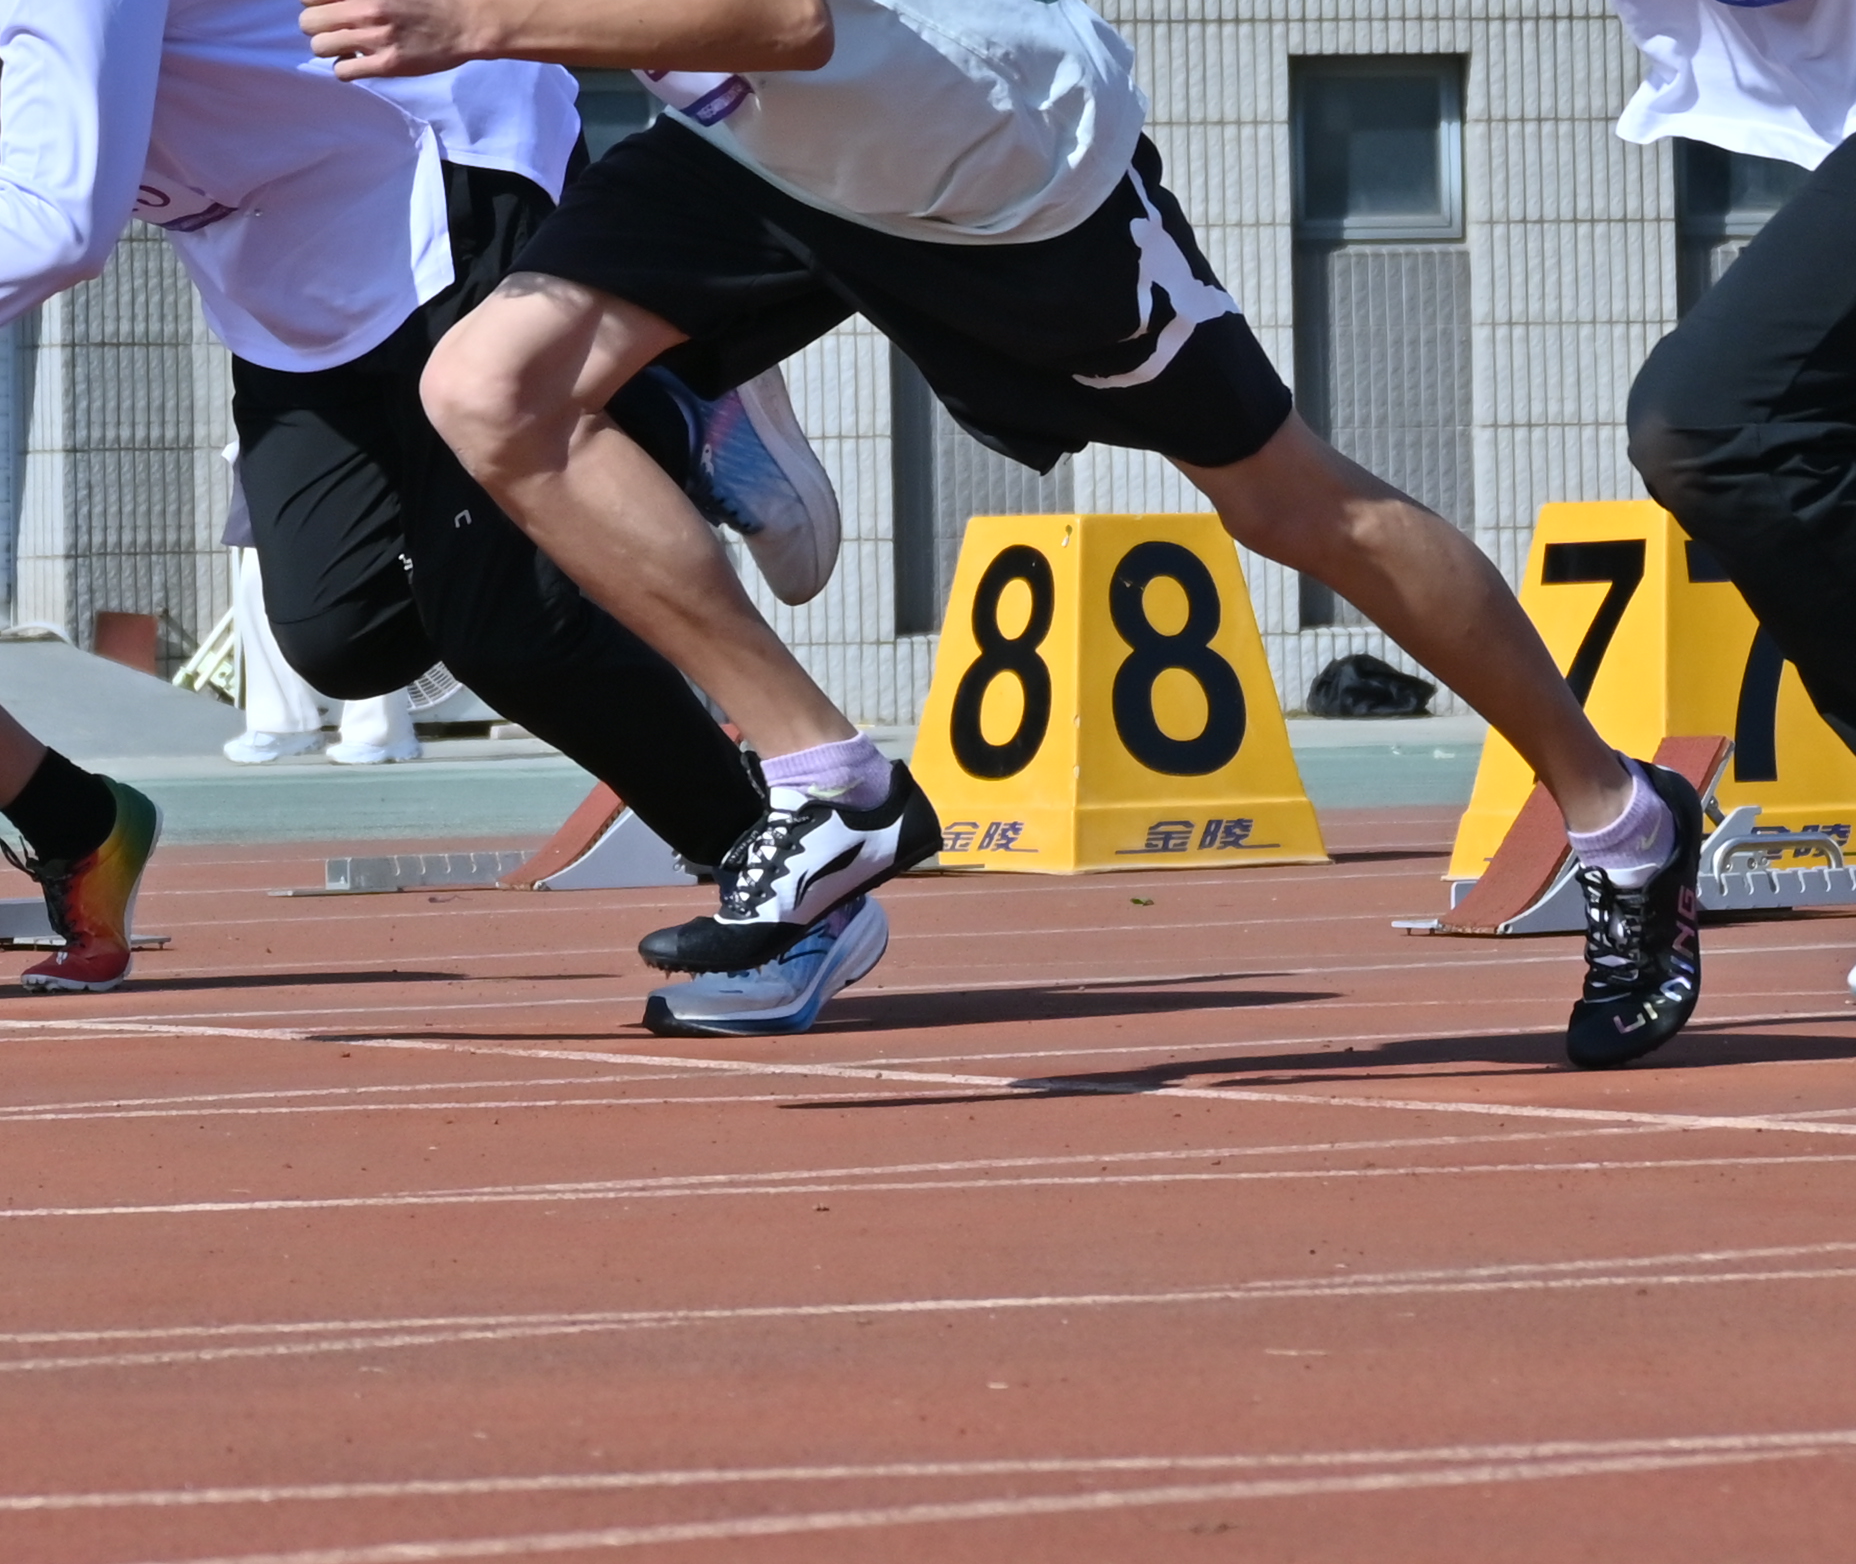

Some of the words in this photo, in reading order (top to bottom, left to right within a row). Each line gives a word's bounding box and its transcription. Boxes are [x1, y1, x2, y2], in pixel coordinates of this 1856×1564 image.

[950, 543, 1055, 781] 8
[1108, 540, 1247, 777] 8
[941, 821, 1038, 854] 金陵
[1115, 818, 1281, 855] 金陵
